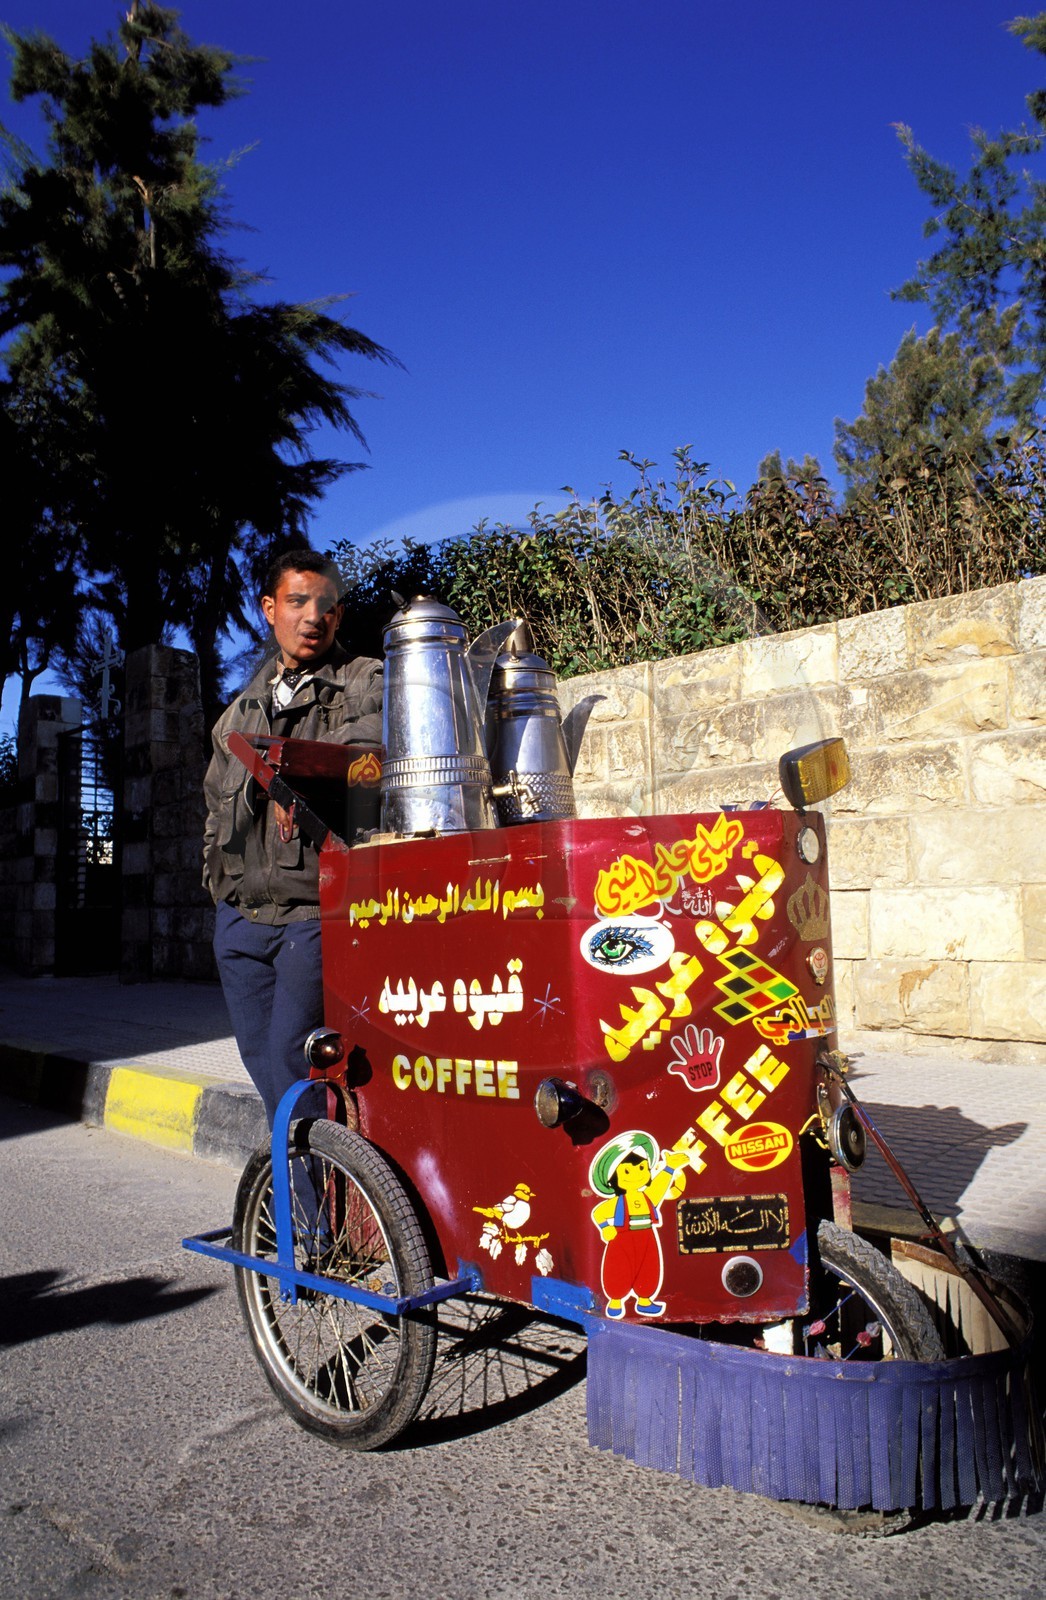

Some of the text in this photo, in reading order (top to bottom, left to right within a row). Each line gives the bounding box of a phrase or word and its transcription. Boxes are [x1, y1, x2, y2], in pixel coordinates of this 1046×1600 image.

[349, 876, 545, 929] بسم الله الرحمن الرحيم
[392, 1054, 520, 1099] COFFEE
[688, 1061, 713, 1081] STOP
[662, 1044, 790, 1201] FFEE
[730, 1134, 785, 1157] NISSAN
